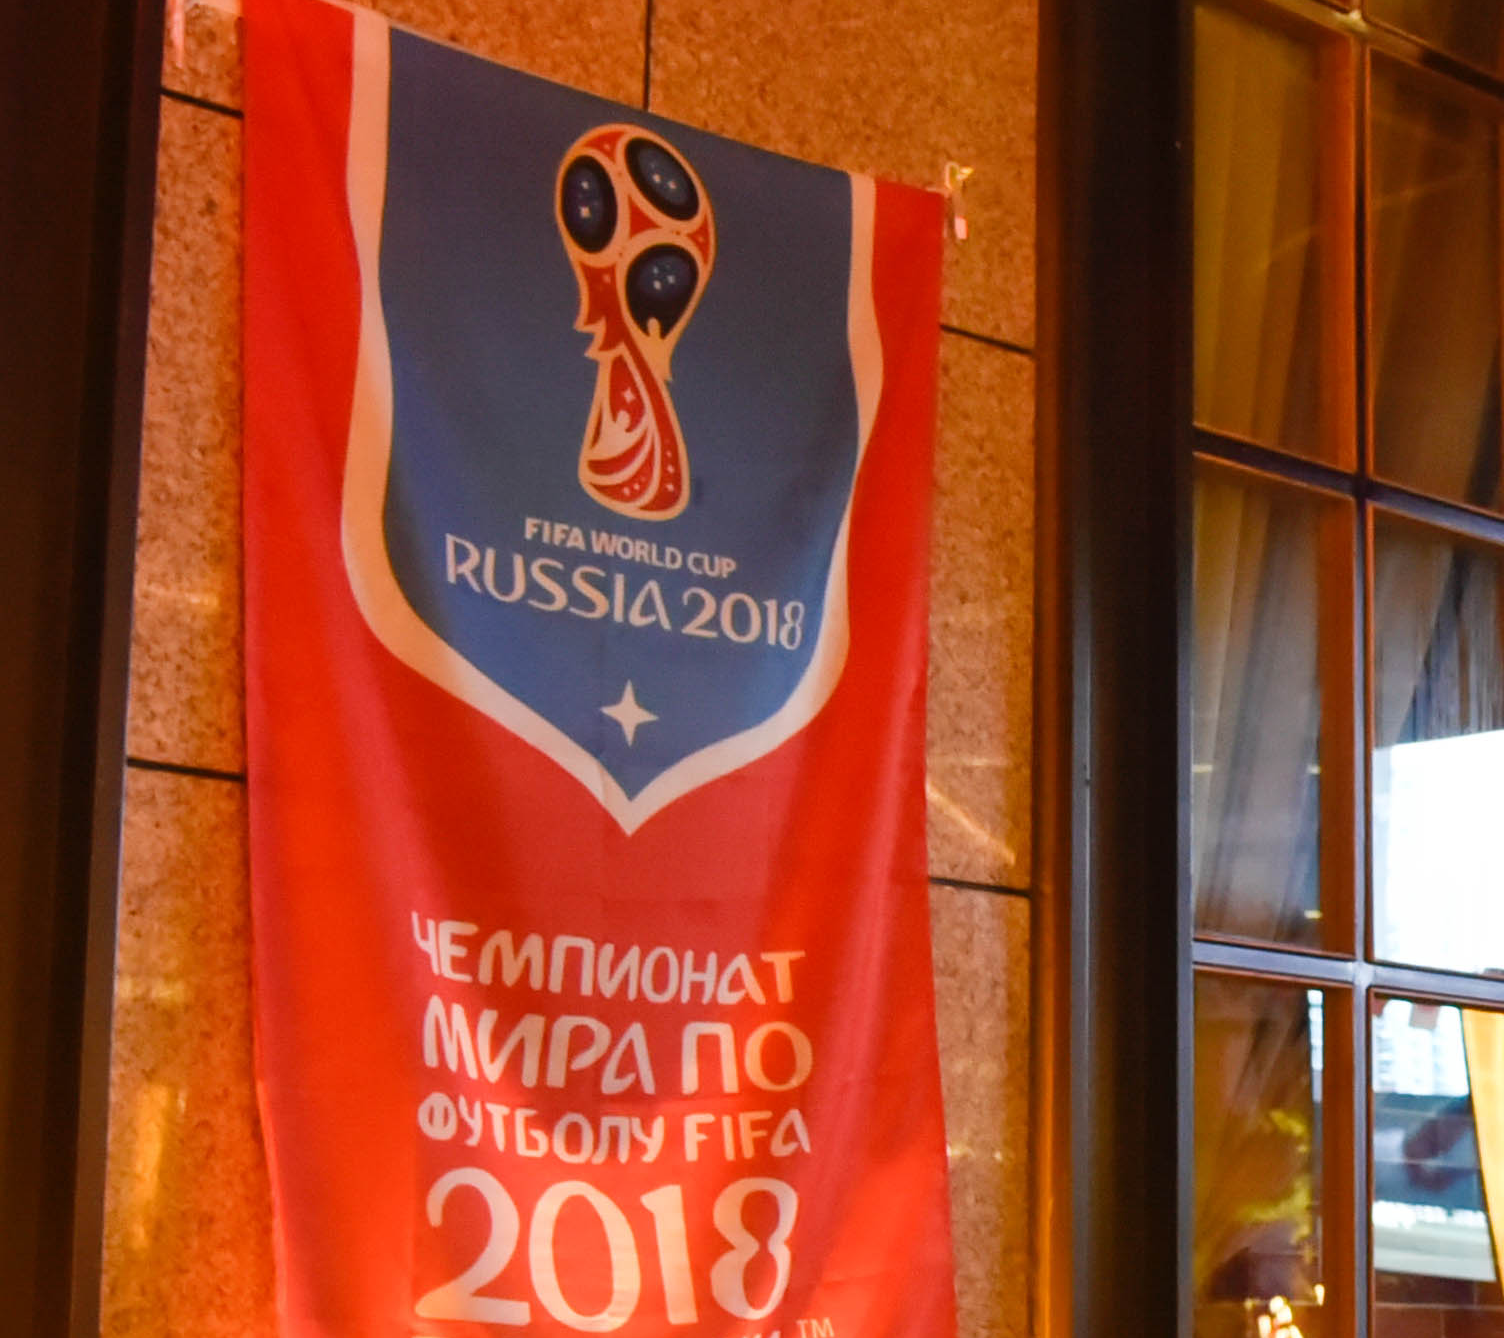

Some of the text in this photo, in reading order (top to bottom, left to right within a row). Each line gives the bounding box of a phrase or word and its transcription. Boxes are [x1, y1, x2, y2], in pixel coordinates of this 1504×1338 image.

[445, 532, 806, 650] RUSSIA 2018
[524, 517, 737, 579] FIFA WORLD CUP
[411, 910, 806, 1007] ЧЕМПИОНАТ
[422, 993, 814, 1096] МИРА ПО
[417, 1090, 812, 1165] ФУТБОЛУ FIFA
[414, 1166, 799, 1333] 2018
